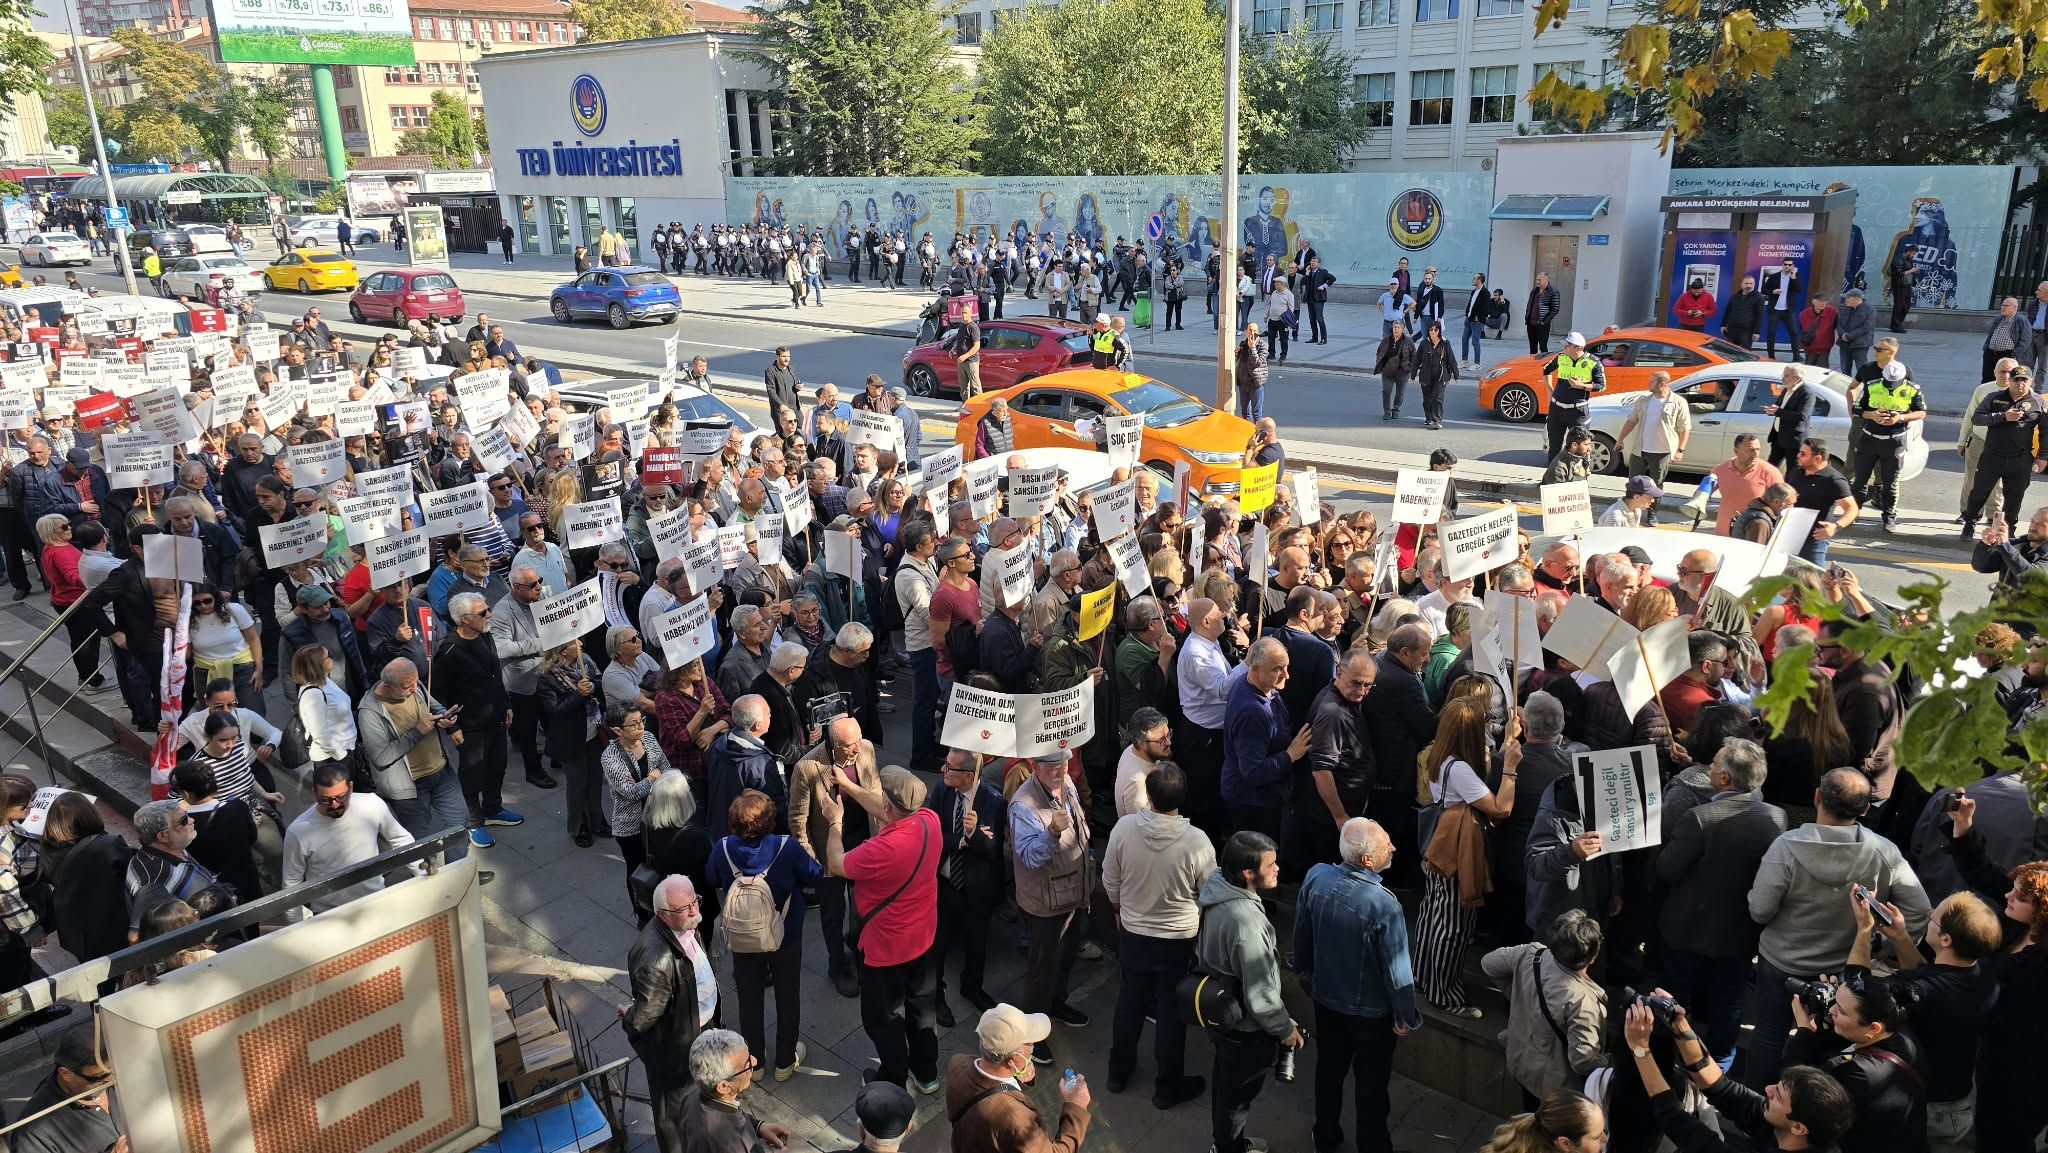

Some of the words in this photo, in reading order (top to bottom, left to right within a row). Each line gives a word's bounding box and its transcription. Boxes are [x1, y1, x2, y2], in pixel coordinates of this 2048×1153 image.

[516, 148, 551, 177] TED
[552, 138, 683, 177] ÜNİVERSİTESİ
[1708, 178, 1770, 189] Merkezindeki
[1774, 179, 1821, 191] Kampüste
[1669, 200, 1704, 208] ANKARA
[1705, 199, 1758, 209] BÜYÜKŞEHİR
[1759, 200, 1810, 208] BELEDİYESİ
[1683, 242, 1698, 250] ÇOK
[1758, 250, 1805, 259] HİZMETİNİZDE
[1759, 243, 1775, 251] ÇOK
[459, 386, 474, 396] SUÇ
[690, 430, 712, 438] Whose
[1111, 433, 1126, 448] SUÇ
[292, 445, 324, 457] DAYANIŞMA
[115, 463, 149, 473] HABERİNİZ
[365, 472, 390, 486] SANSÜRE
[390, 470, 406, 482] HAYIR
[429, 494, 459, 507] SANSÜRE
[460, 488, 477, 500] HAYIR
[1013, 487, 1039, 496] SANSÜR
[343, 500, 372, 514] GAZETECİYE
[428, 508, 454, 522] HABERE
[454, 500, 484, 516] ÖZGÜRLÜK!
[570, 519, 602, 532] HABERİNİZ
[656, 527, 678, 542] SANSÜR
[1447, 523, 1488, 542] GAZETECİYE
[268, 537, 303, 552] HABERİNİZ
[304, 533, 315, 543] VAR
[375, 538, 403, 555] SANSÜRE
[404, 534, 421, 546] HAYIR
[1456, 535, 1486, 554] GERÇEĞE
[373, 558, 397, 572] HABERE
[397, 546, 427, 564] ÖZGÜRLÜK!
[1003, 568, 1025, 587] HABERE
[538, 605, 575, 626] HABERİNİZ
[575, 598, 588, 611] VAR
[545, 602, 559, 612] HALK
[663, 620, 696, 642] HABERİNİZ
[695, 614, 704, 628] VAR
[668, 614, 682, 626] HALK
[955, 689, 996, 708] DAYANIŞMA
[1041, 689, 1080, 706] GAZETECİLER
[954, 703, 997, 721] GAZETECİLİK
[998, 712, 1016, 724] OLM
[1042, 701, 1080, 719] YAZAMAZSA
[1043, 713, 1080, 731] GERÇEKLERİ
[1602, 766, 1617, 795] değil
[1619, 762, 1637, 804] yanıltır
[1605, 798, 1620, 842] Gazeteci
[1624, 805, 1636, 839] sansür
